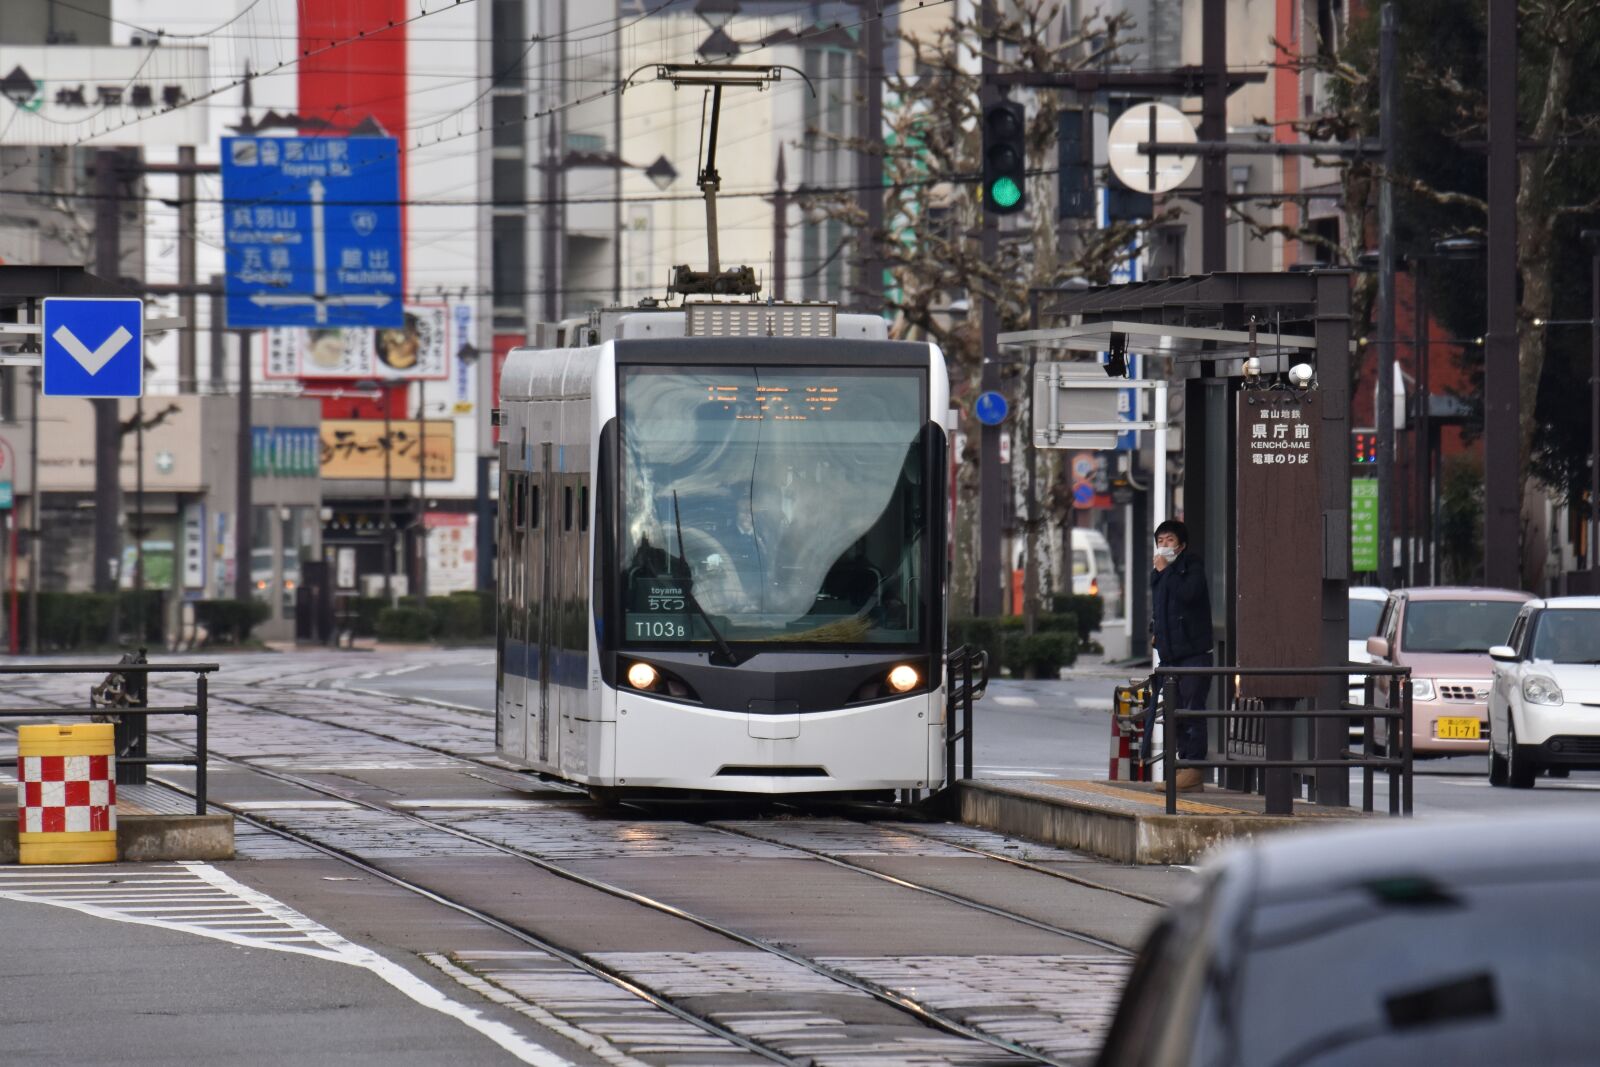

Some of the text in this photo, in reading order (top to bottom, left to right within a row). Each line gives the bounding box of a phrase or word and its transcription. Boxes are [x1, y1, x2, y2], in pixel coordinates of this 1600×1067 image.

[1260, 409, 1301, 419] 富山地鉄
[1252, 423, 1310, 439] 県庁前
[1252, 453, 1309, 465] 電車のりば
[650, 587, 683, 596] toyama
[648, 598, 685, 610] ちてつ
